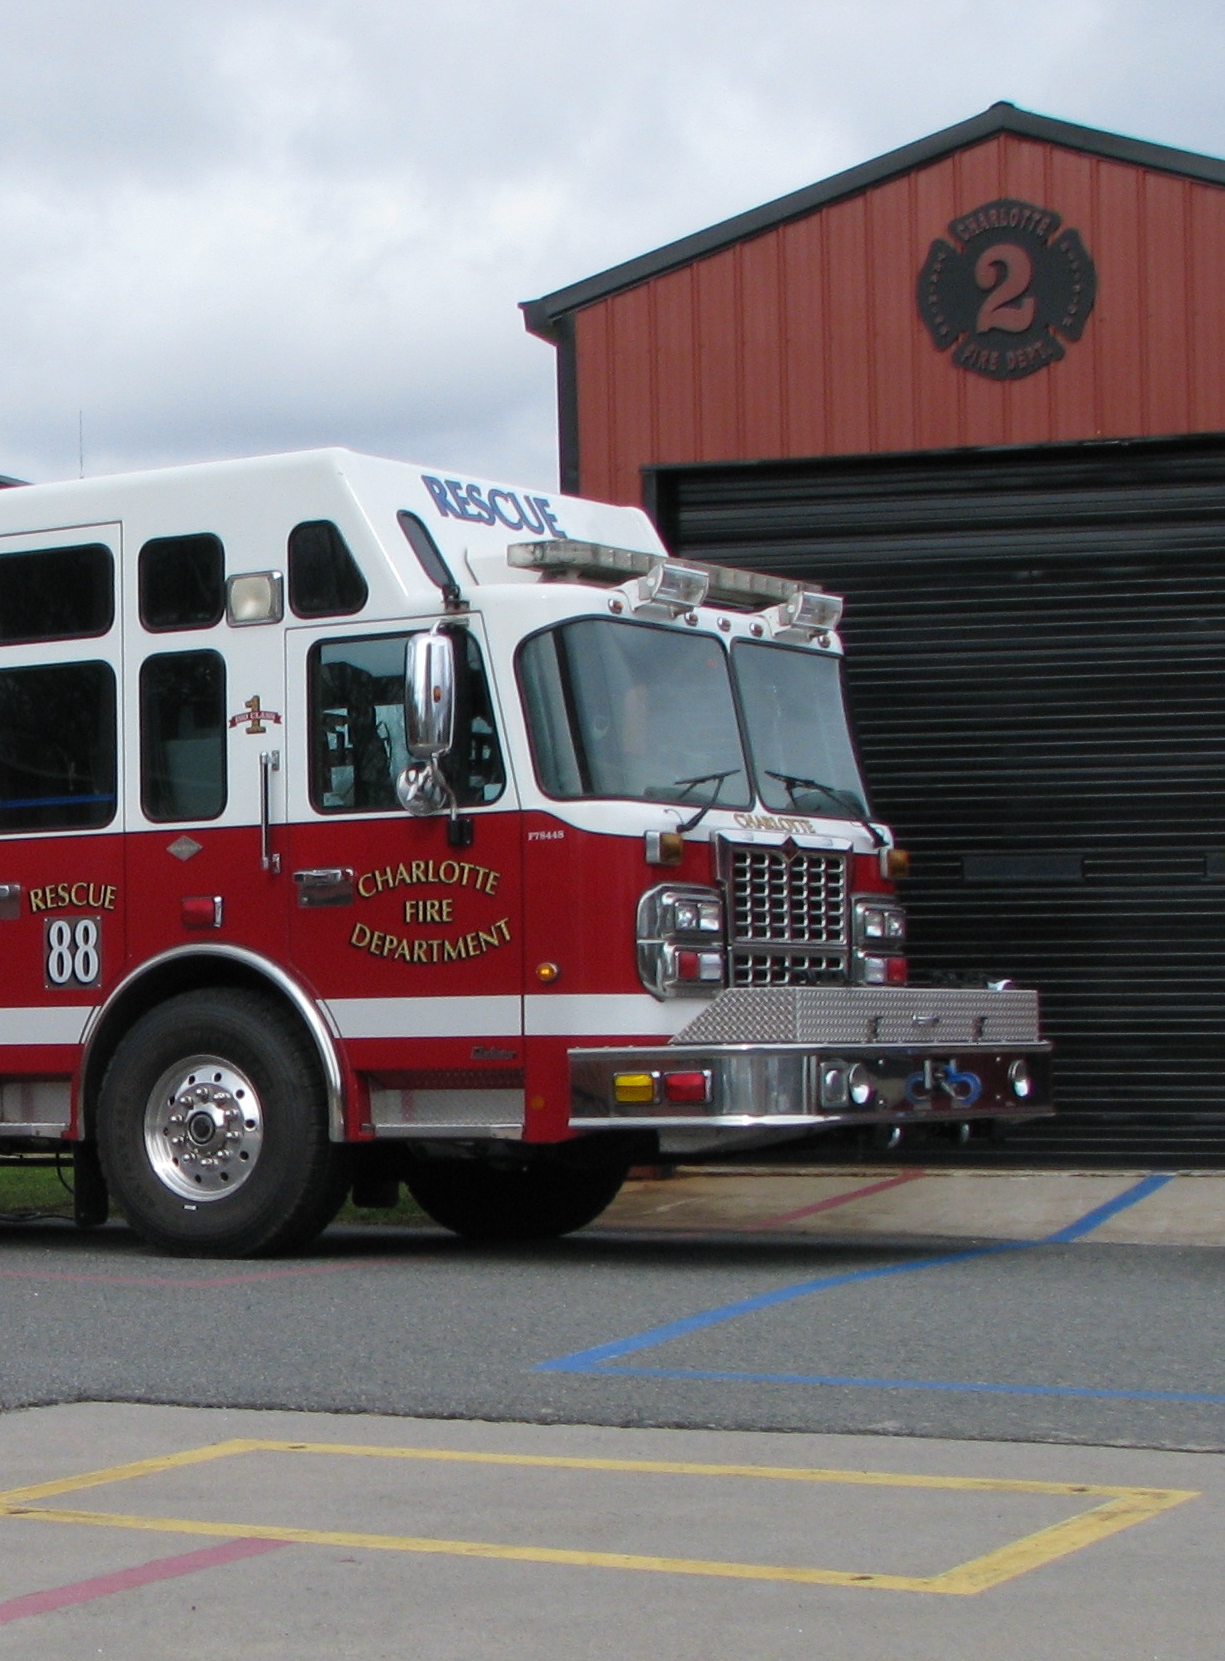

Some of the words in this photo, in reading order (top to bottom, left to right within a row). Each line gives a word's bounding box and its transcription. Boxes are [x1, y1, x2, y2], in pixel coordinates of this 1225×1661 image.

[956, 208, 1052, 241] CHARLOTTE
[976, 242, 1037, 334] 2
[960, 342, 1001, 371] FIRE
[421, 475, 567, 539] RESCUE
[733, 812, 816, 834] CHARLOTTE
[357, 859, 501, 898] CHARLOTTE
[29, 881, 118, 914] RESCUE
[404, 899, 454, 923] FIRE
[48, 919, 100, 985] 88
[349, 917, 512, 964] DEPARTMENT
